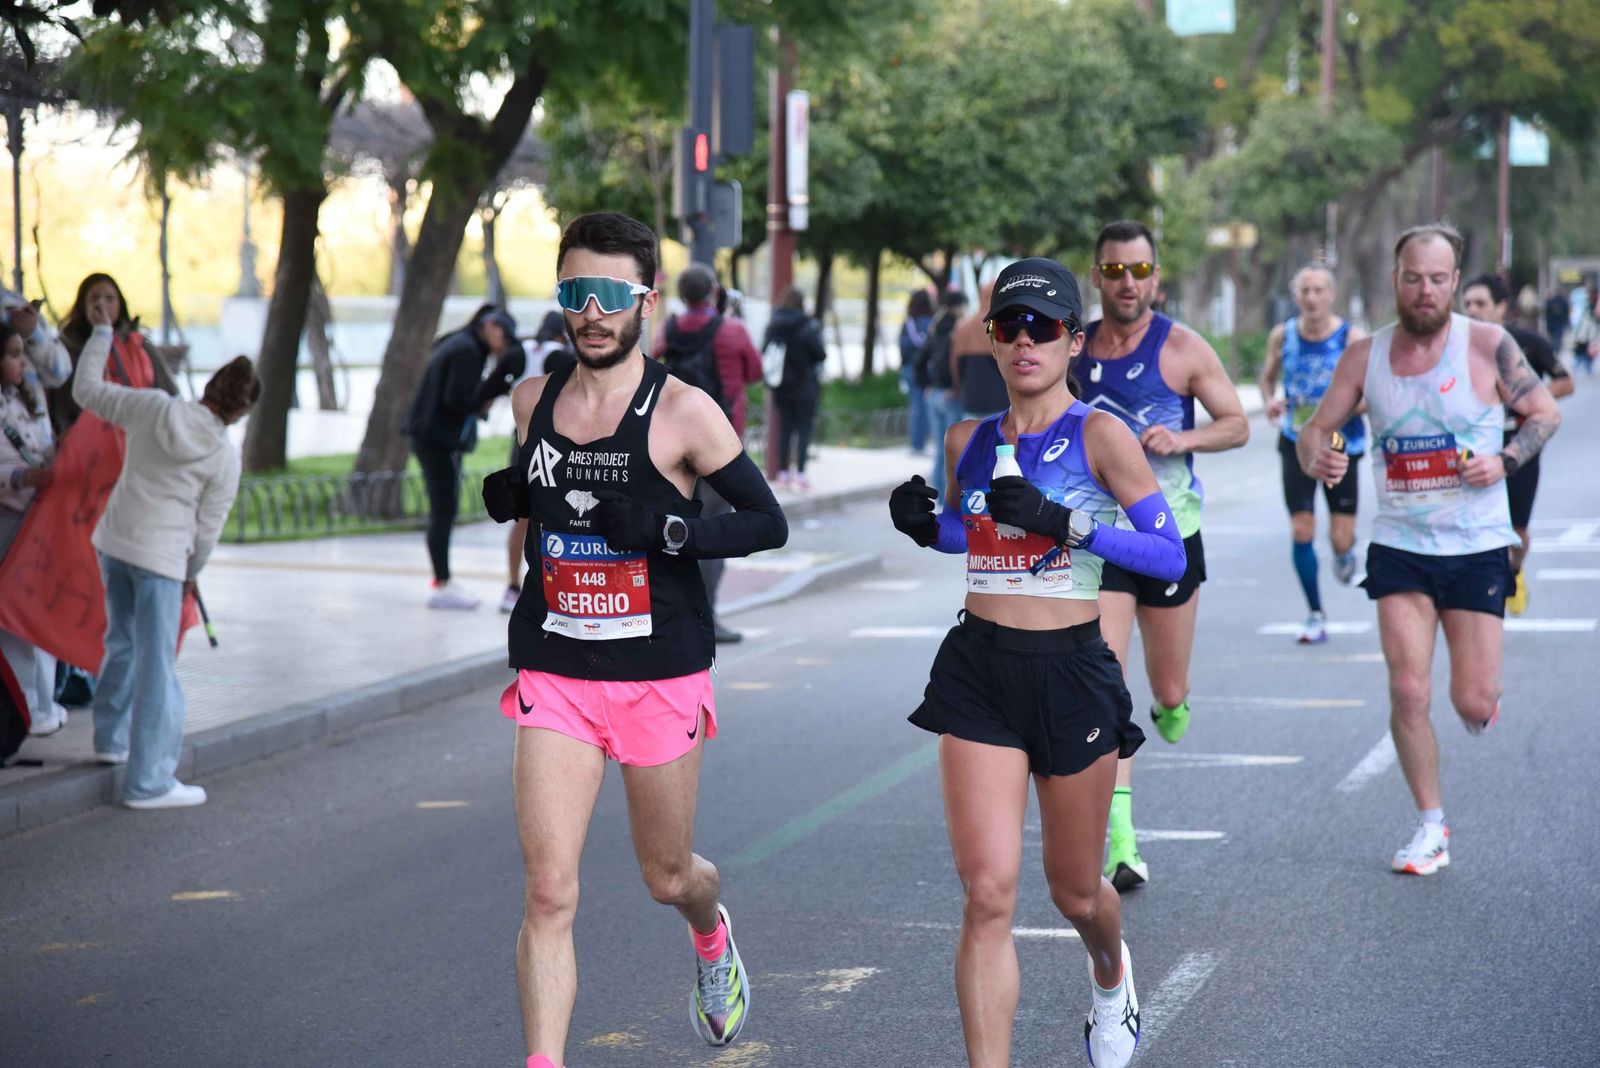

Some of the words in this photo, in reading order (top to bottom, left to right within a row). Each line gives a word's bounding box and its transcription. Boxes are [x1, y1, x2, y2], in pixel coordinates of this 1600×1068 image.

[1403, 438, 1447, 451] ZURICH
[567, 451, 593, 466] ARES
[593, 452, 630, 466] PROJECT
[566, 467, 629, 482] RUNNERS
[969, 554, 1026, 571] MICHELLE
[573, 572, 606, 586] 1448
[558, 591, 630, 615] SERGIO
